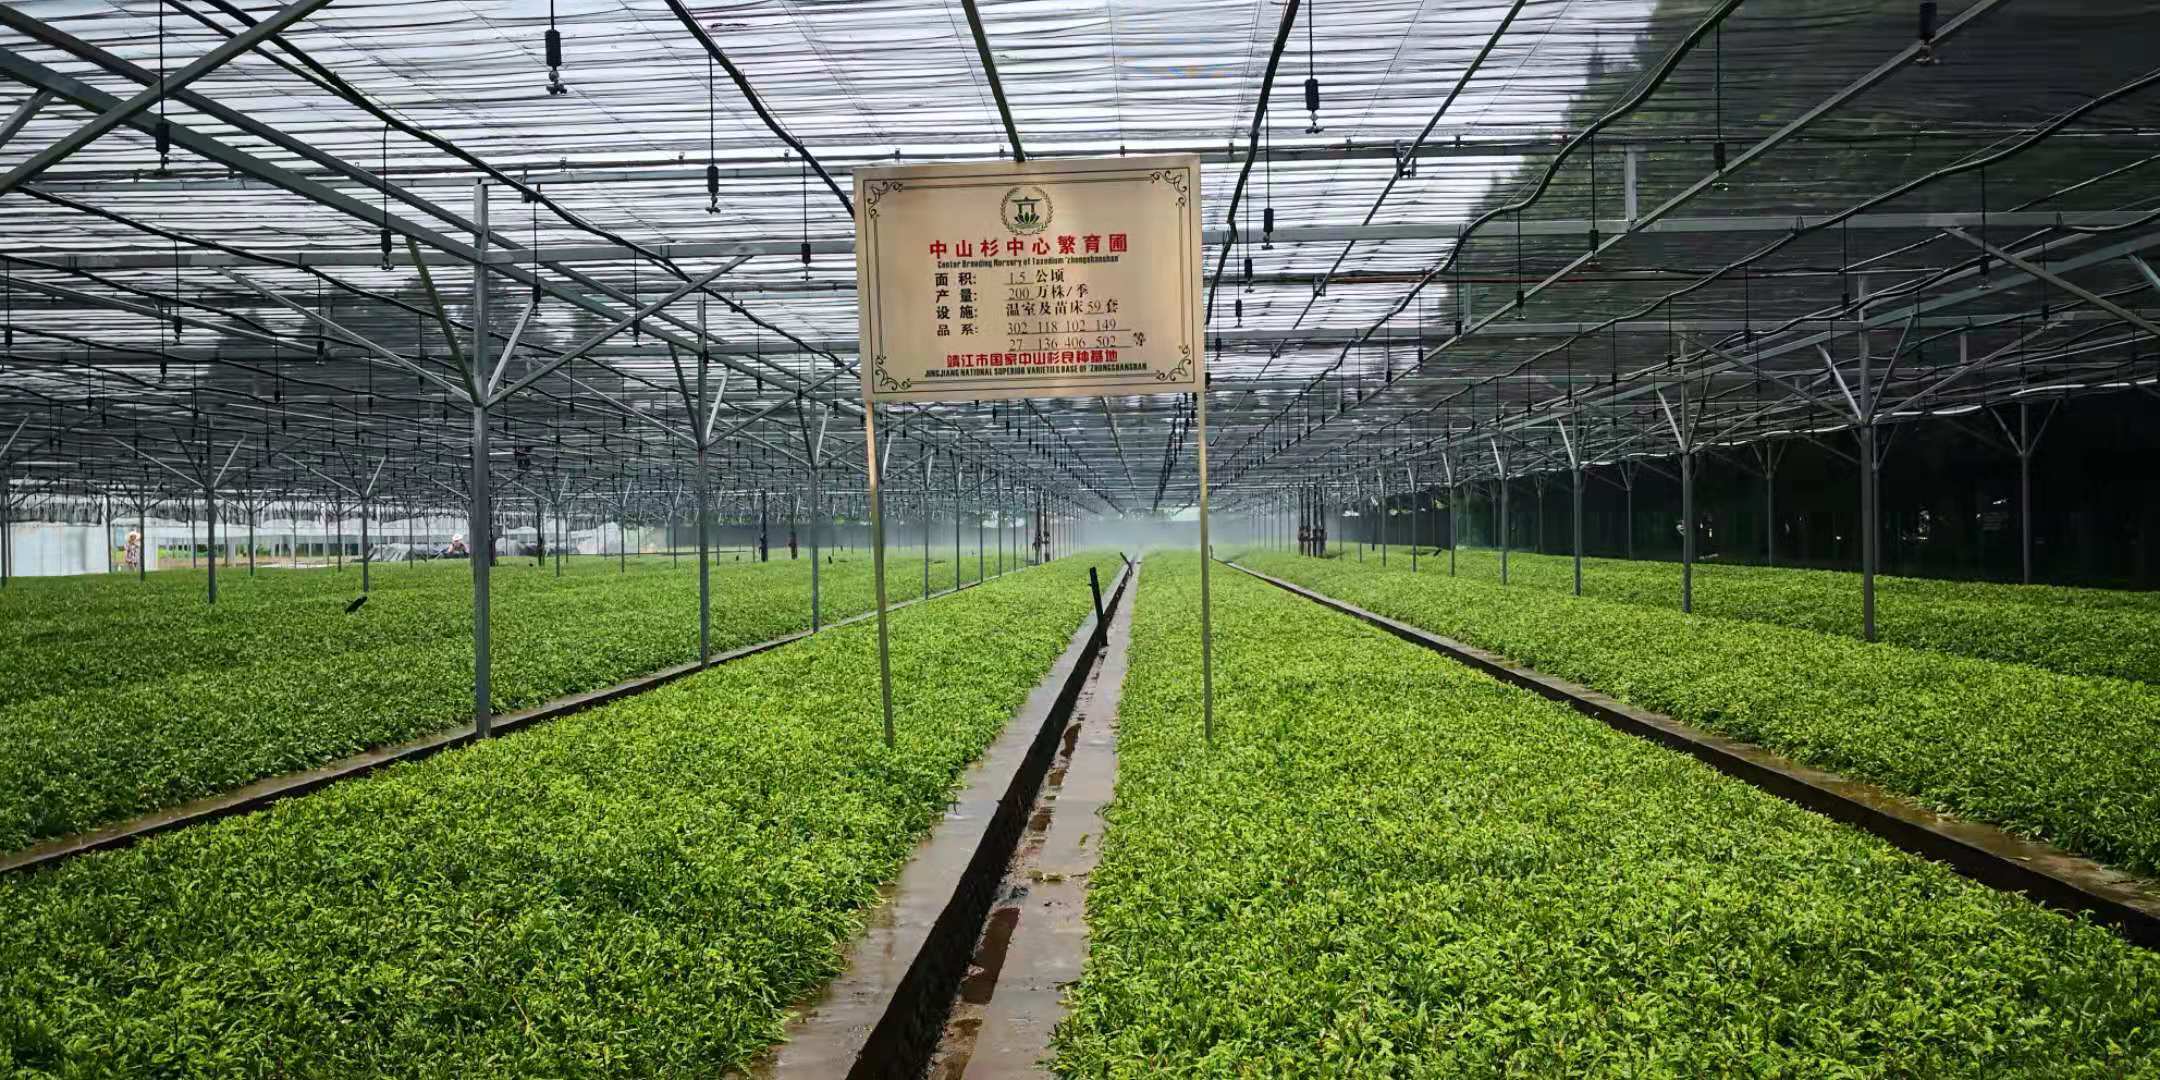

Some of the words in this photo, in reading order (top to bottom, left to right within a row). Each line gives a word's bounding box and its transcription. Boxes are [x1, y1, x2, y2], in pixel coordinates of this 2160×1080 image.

[929, 234, 1127, 259] 中山杉中心繁育圃
[1008, 288, 1030, 300] 200
[1007, 322, 1027, 334] 302
[1097, 319, 1116, 331] 149
[1009, 339, 1023, 351] 27
[1096, 335, 1116, 348] 502
